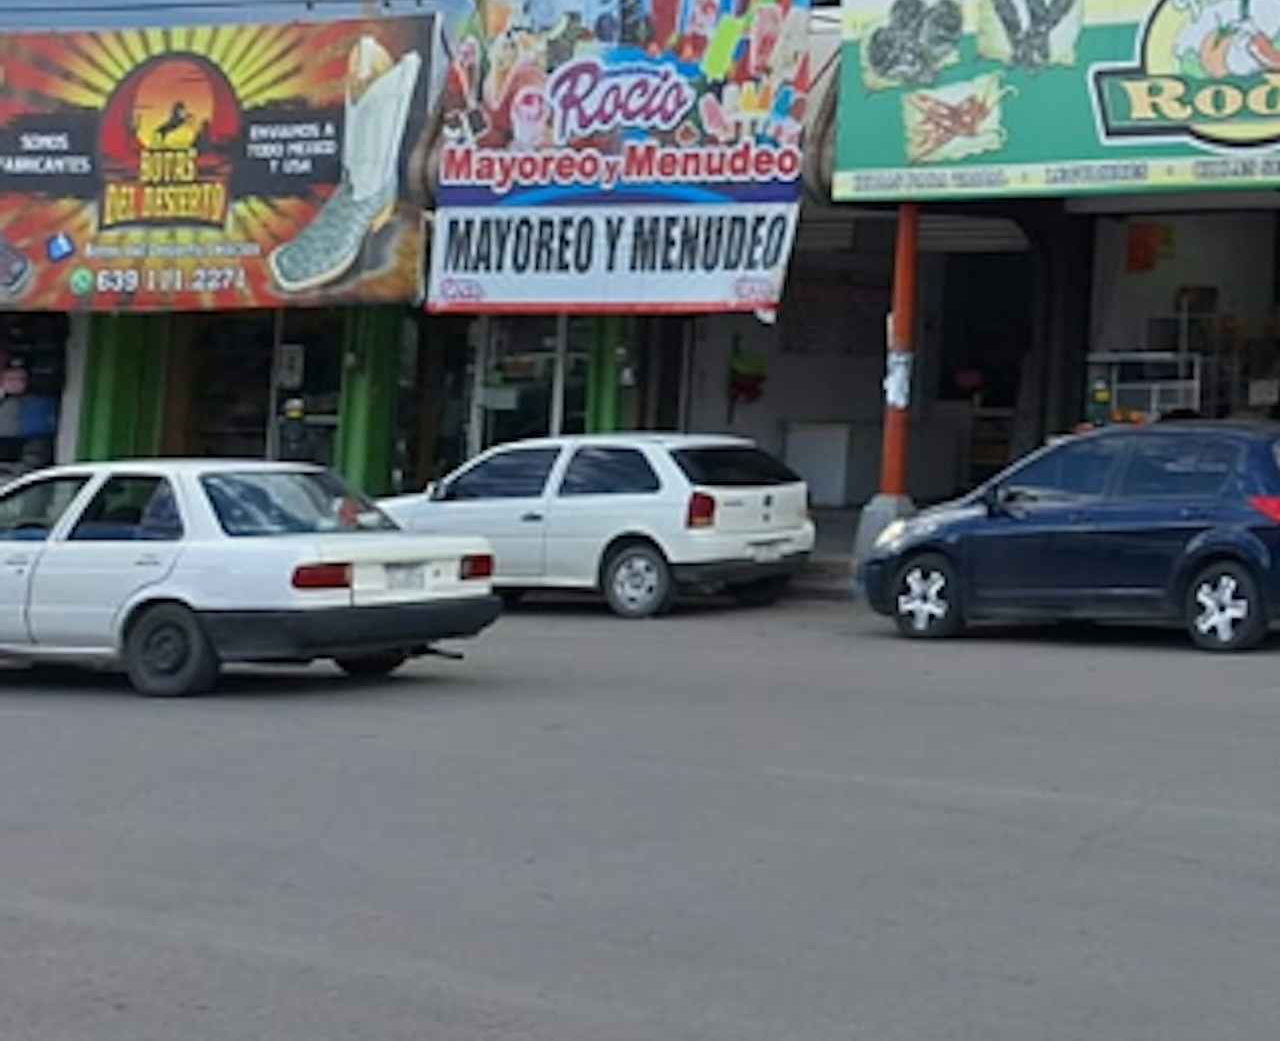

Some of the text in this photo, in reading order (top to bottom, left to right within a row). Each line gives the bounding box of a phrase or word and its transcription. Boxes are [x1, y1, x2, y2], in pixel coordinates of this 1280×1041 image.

[20, 132, 69, 151] SOMOS
[324, 122, 336, 137] A
[140, 148, 196, 182] BOTAS
[282, 158, 312, 175] USA
[443, 144, 799, 187] Mayoreo y Menudeo
[444, 213, 787, 274] MAYOREO Y MENUDEO
[97, 269, 139, 293] 639
